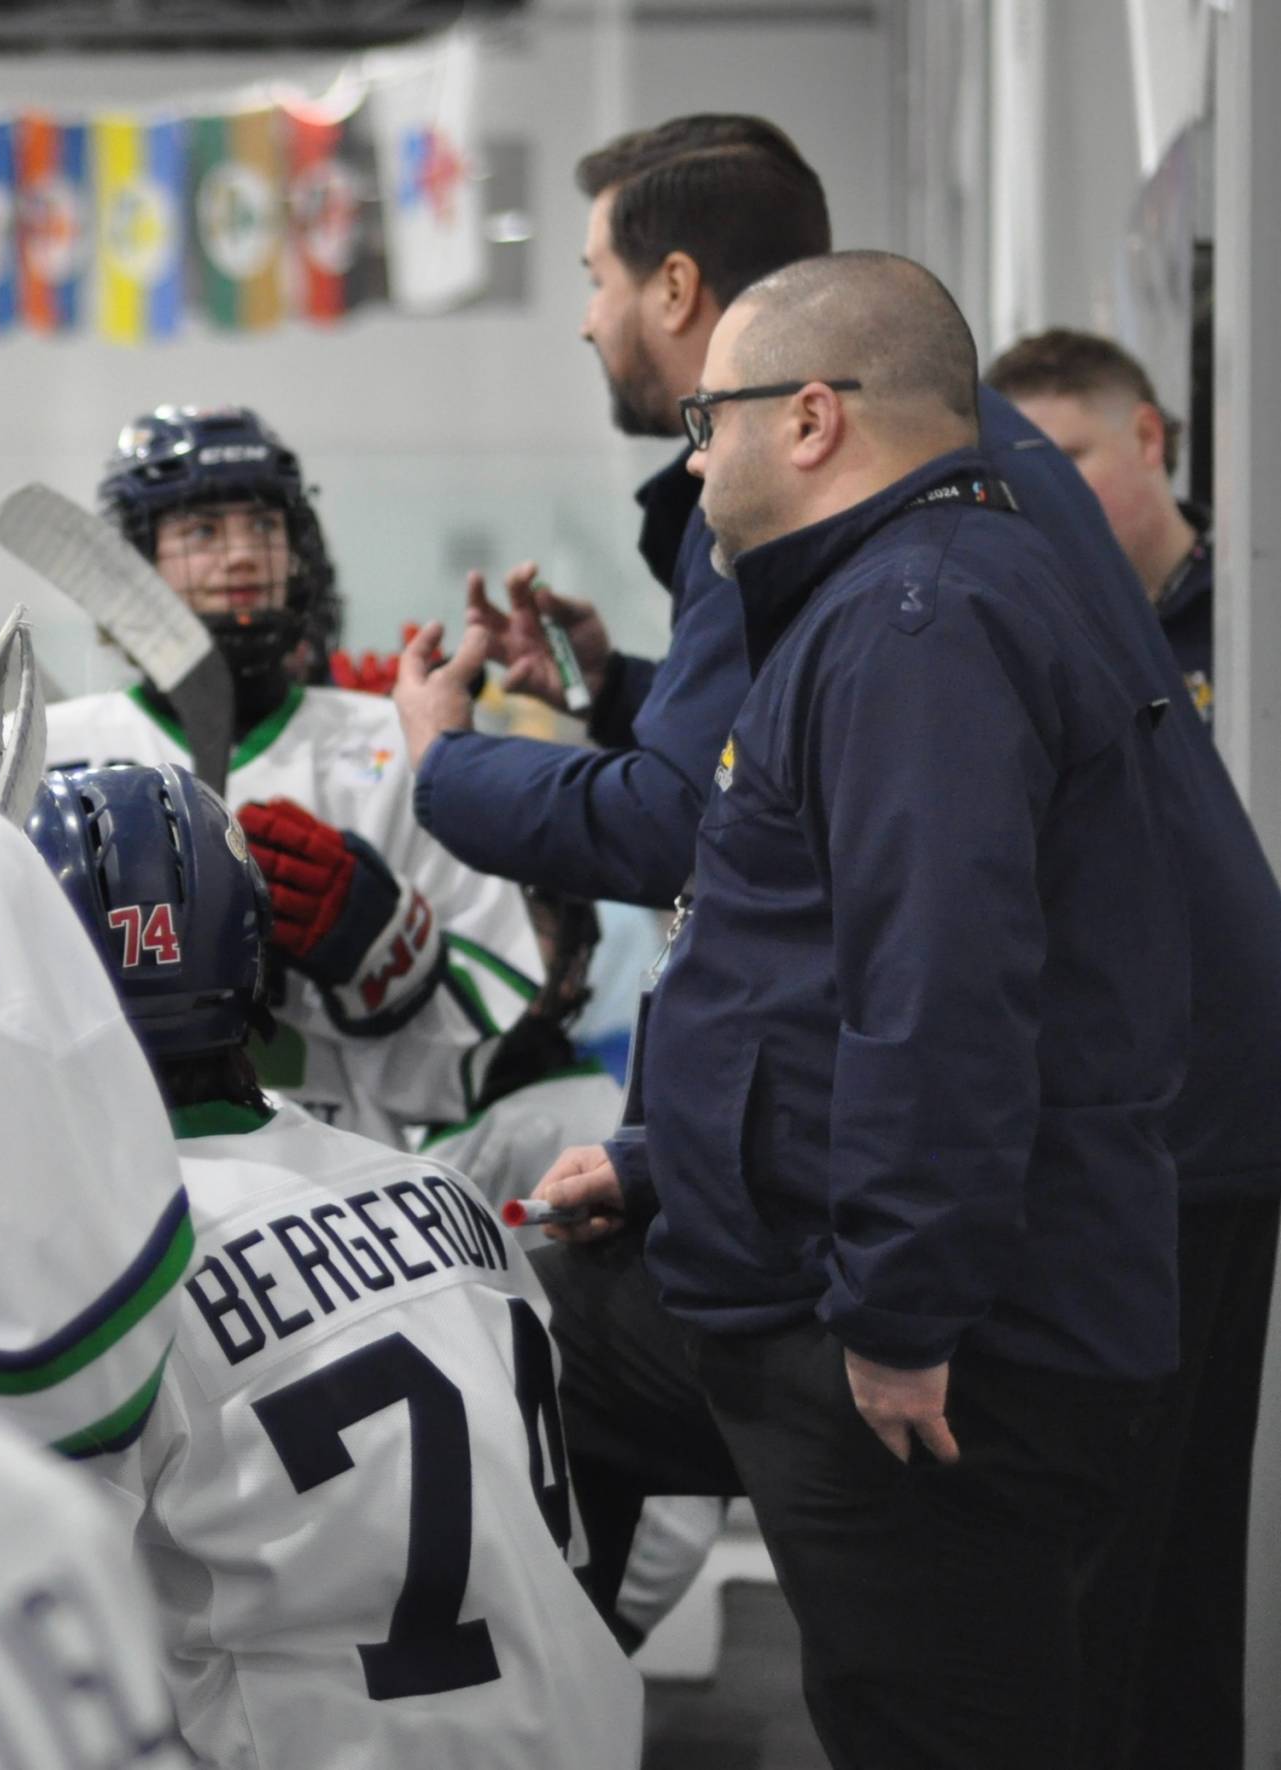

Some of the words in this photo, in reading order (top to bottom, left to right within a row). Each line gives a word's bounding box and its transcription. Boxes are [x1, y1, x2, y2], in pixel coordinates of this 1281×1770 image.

[927, 485, 960, 502] 2024
[107, 903, 181, 968] 74
[184, 1175, 508, 1366] BERGERON
